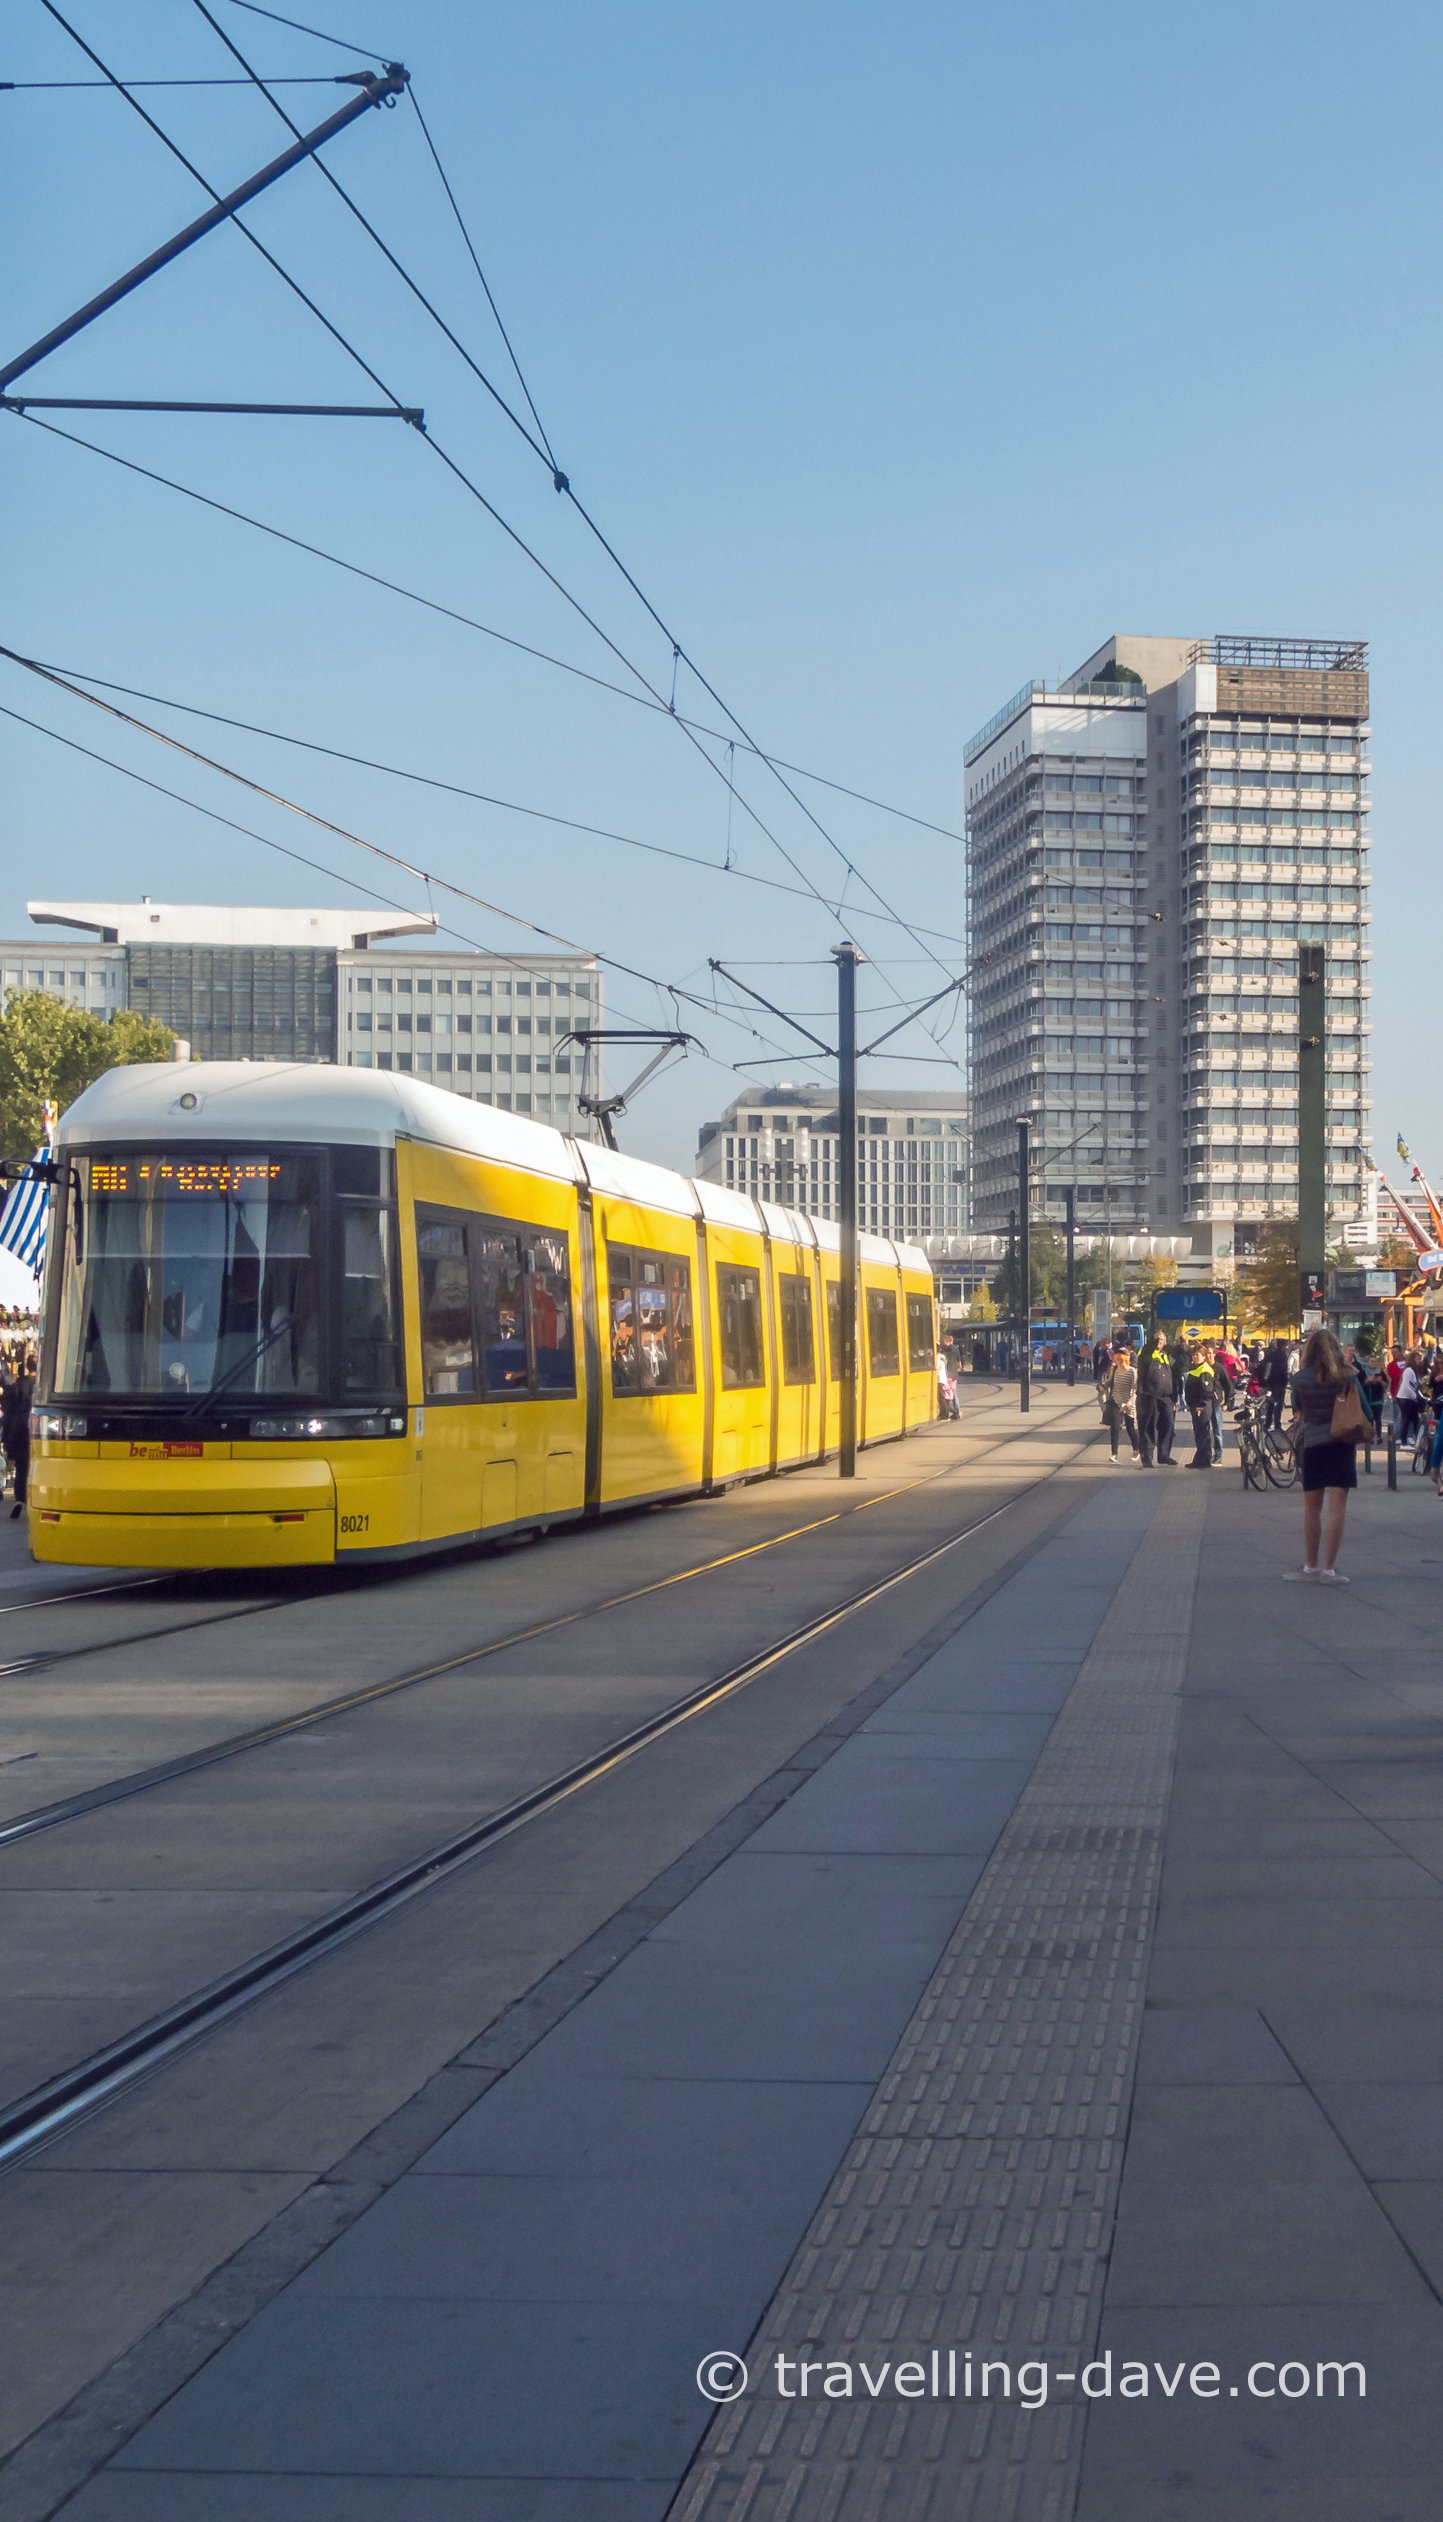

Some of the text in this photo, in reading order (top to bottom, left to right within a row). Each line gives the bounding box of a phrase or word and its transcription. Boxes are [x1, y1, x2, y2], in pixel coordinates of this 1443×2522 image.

[1183, 1295, 1195, 1308] U
[129, 1441, 200, 1458] be Berlin
[340, 1514, 370, 1534] 8021
